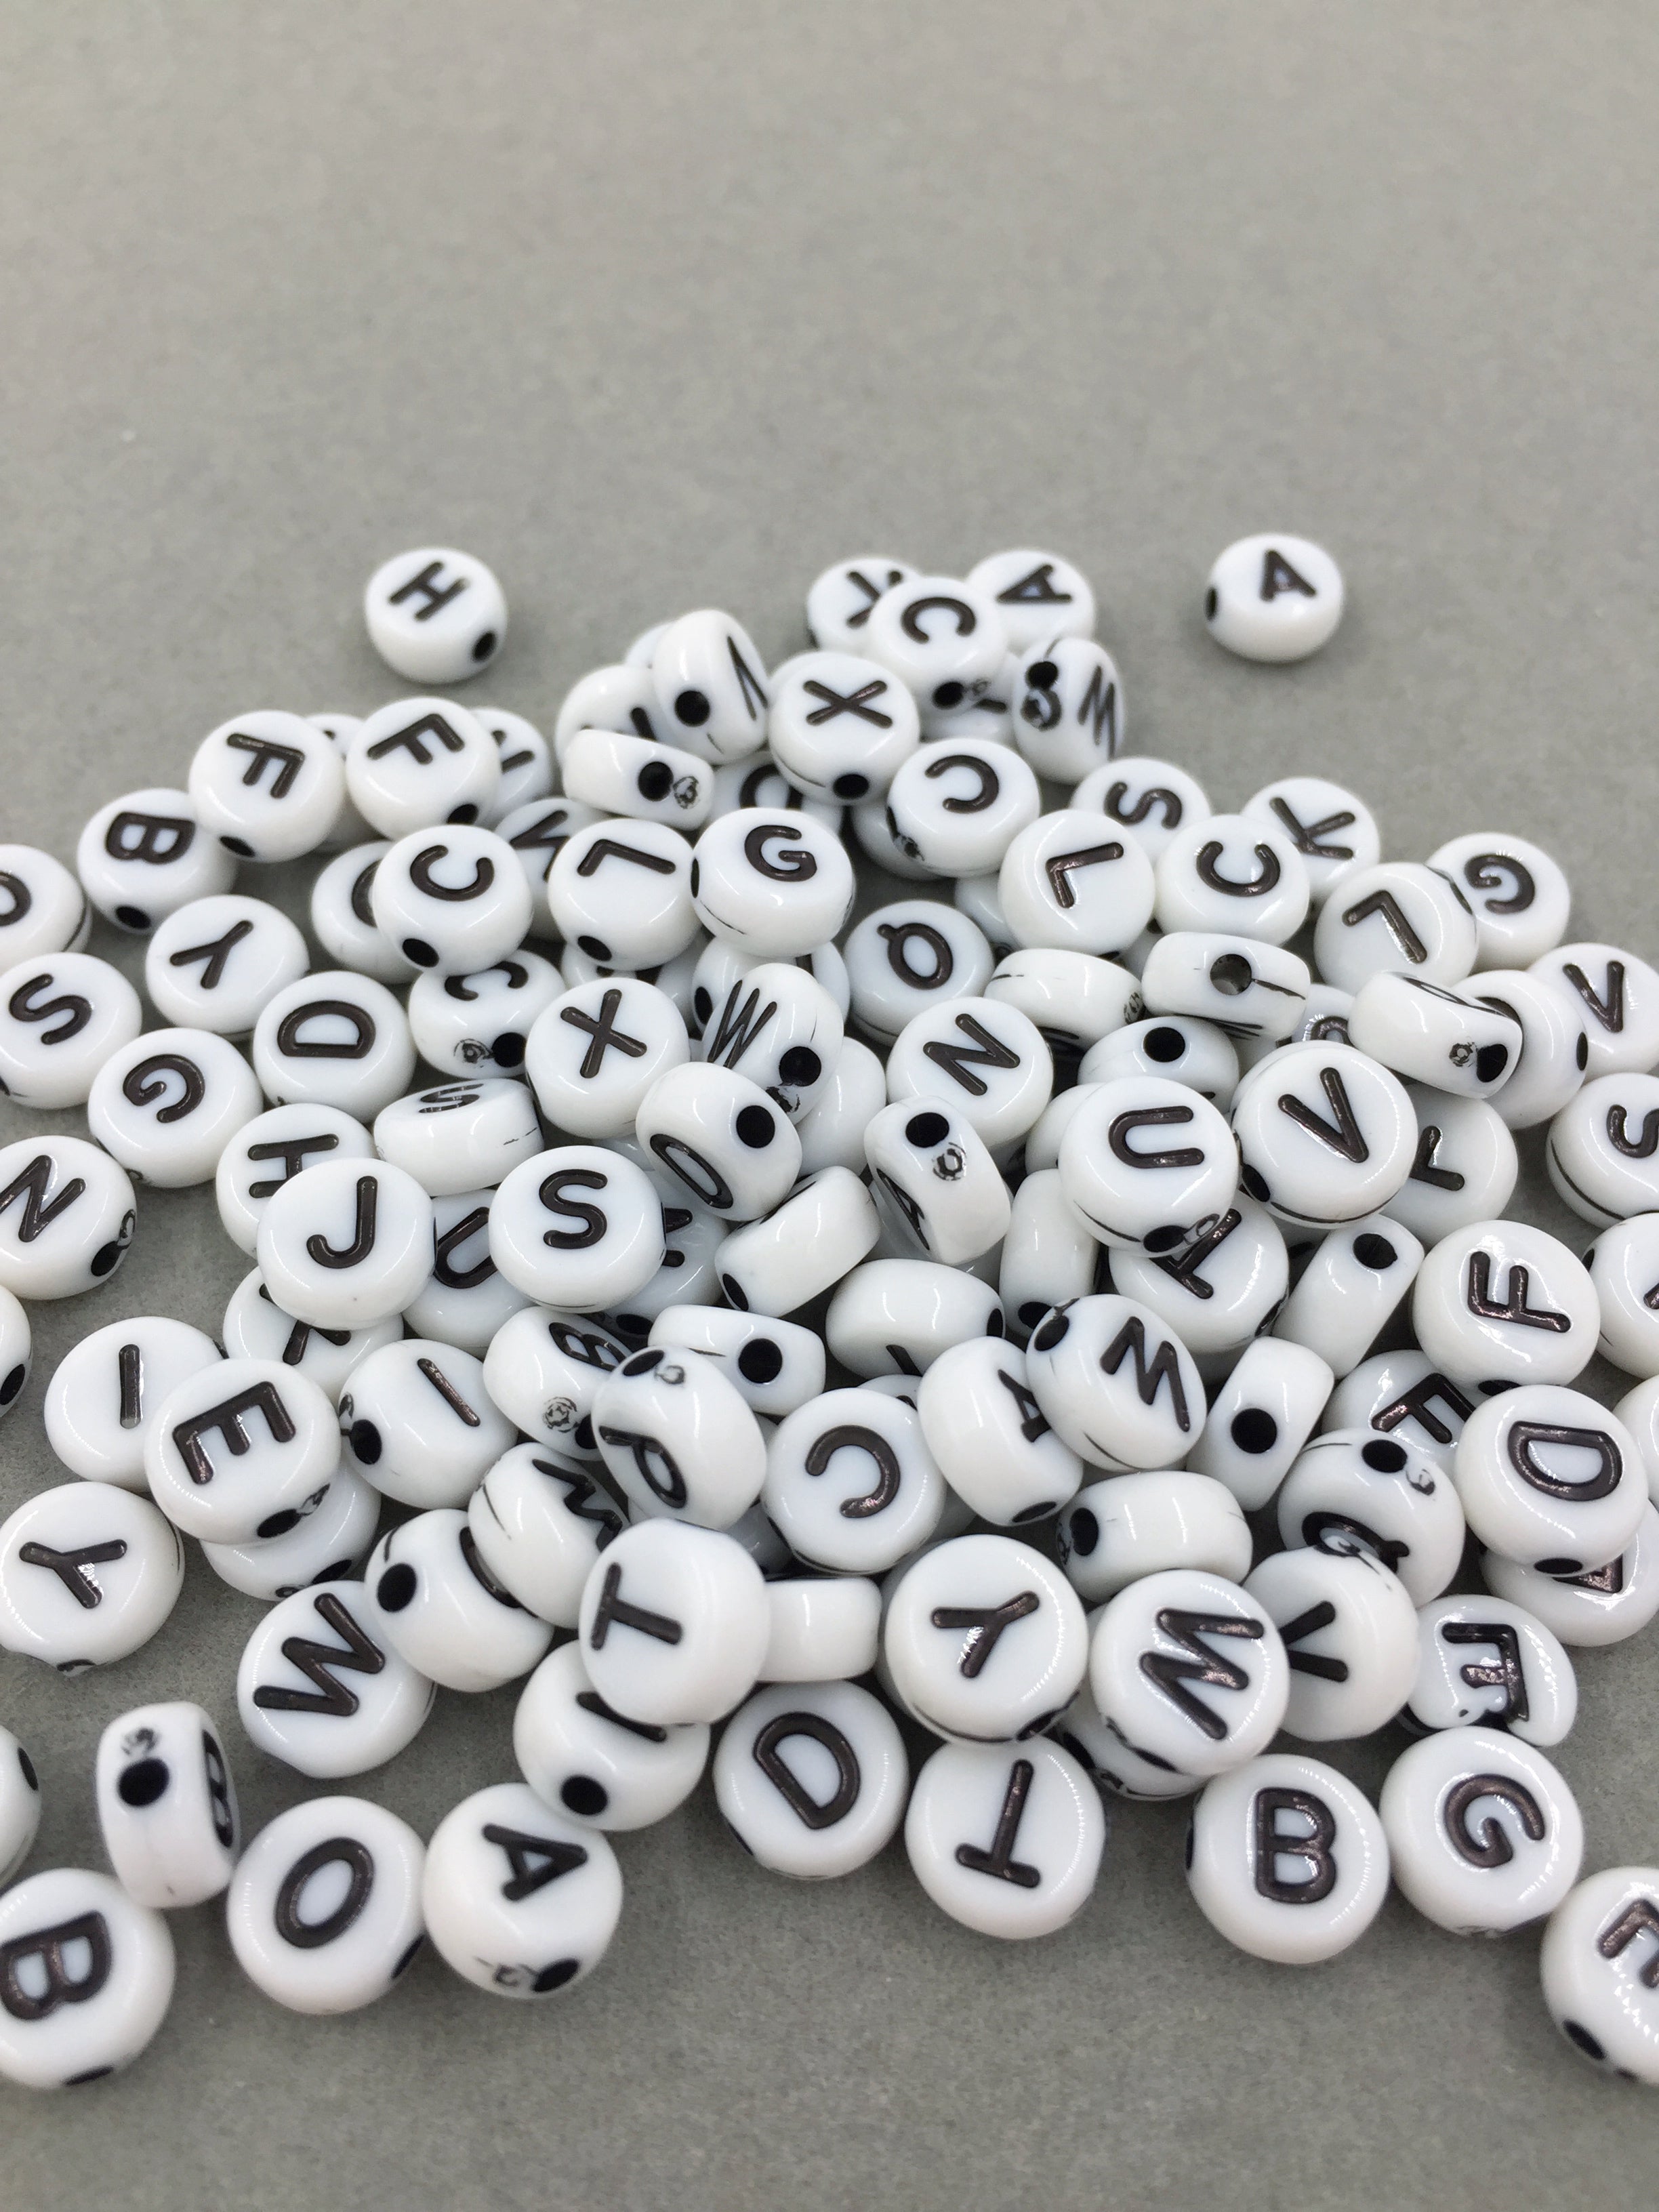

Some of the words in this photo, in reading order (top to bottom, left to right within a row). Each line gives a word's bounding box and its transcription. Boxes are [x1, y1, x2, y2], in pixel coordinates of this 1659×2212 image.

[388, 560, 469, 621] H
[997, 563, 1072, 603] A
[1261, 550, 1317, 601] A
[901, 596, 977, 643] C
[367, 713, 465, 764] F
[803, 680, 893, 729] X
[226, 733, 306, 800] F
[924, 754, 1000, 813] C
[105, 811, 196, 865] B
[1105, 781, 1182, 831] S
[1269, 797, 1356, 860] K
[409, 844, 495, 902] C
[577, 838, 676, 877] L
[745, 823, 818, 882] G
[1046, 842, 1124, 908] L
[1195, 841, 1282, 897] C
[1465, 853, 1536, 914] G
[169, 920, 254, 989] Y
[876, 922, 954, 990] Q
[1343, 890, 1428, 965] L
[9, 973, 92, 1045] S
[277, 1000, 377, 1059] D
[1562, 960, 1625, 1033] V
[560, 988, 648, 1079] X
[922, 1012, 1021, 1097] N
[123, 1053, 205, 1124] G
[1277, 1066, 1370, 1164] V
[247, 1133, 340, 1199] H
[1108, 1105, 1205, 1169] U
[0, 1154, 86, 1243] N
[306, 1175, 378, 1270] J
[539, 1168, 609, 1250] S
[1467, 1250, 1572, 1333] F
[119, 1344, 143, 1429] I
[417, 1357, 481, 1427] I
[171, 1380, 298, 1486] E
[598, 1425, 688, 1509] P
[1509, 1420, 1624, 1502] D
[805, 1425, 901, 1518] C
[19, 1539, 128, 1610] Y
[590, 1562, 684, 1651] T
[931, 1590, 1041, 1679] Y
[753, 1711, 861, 1830] D
[955, 1758, 1042, 1889] T
[1254, 1786, 1337, 1904] B
[1444, 1773, 1546, 1868] G
[275, 1836, 375, 1950] O
[482, 1822, 588, 1902] A
[0, 1910, 112, 2022] B
